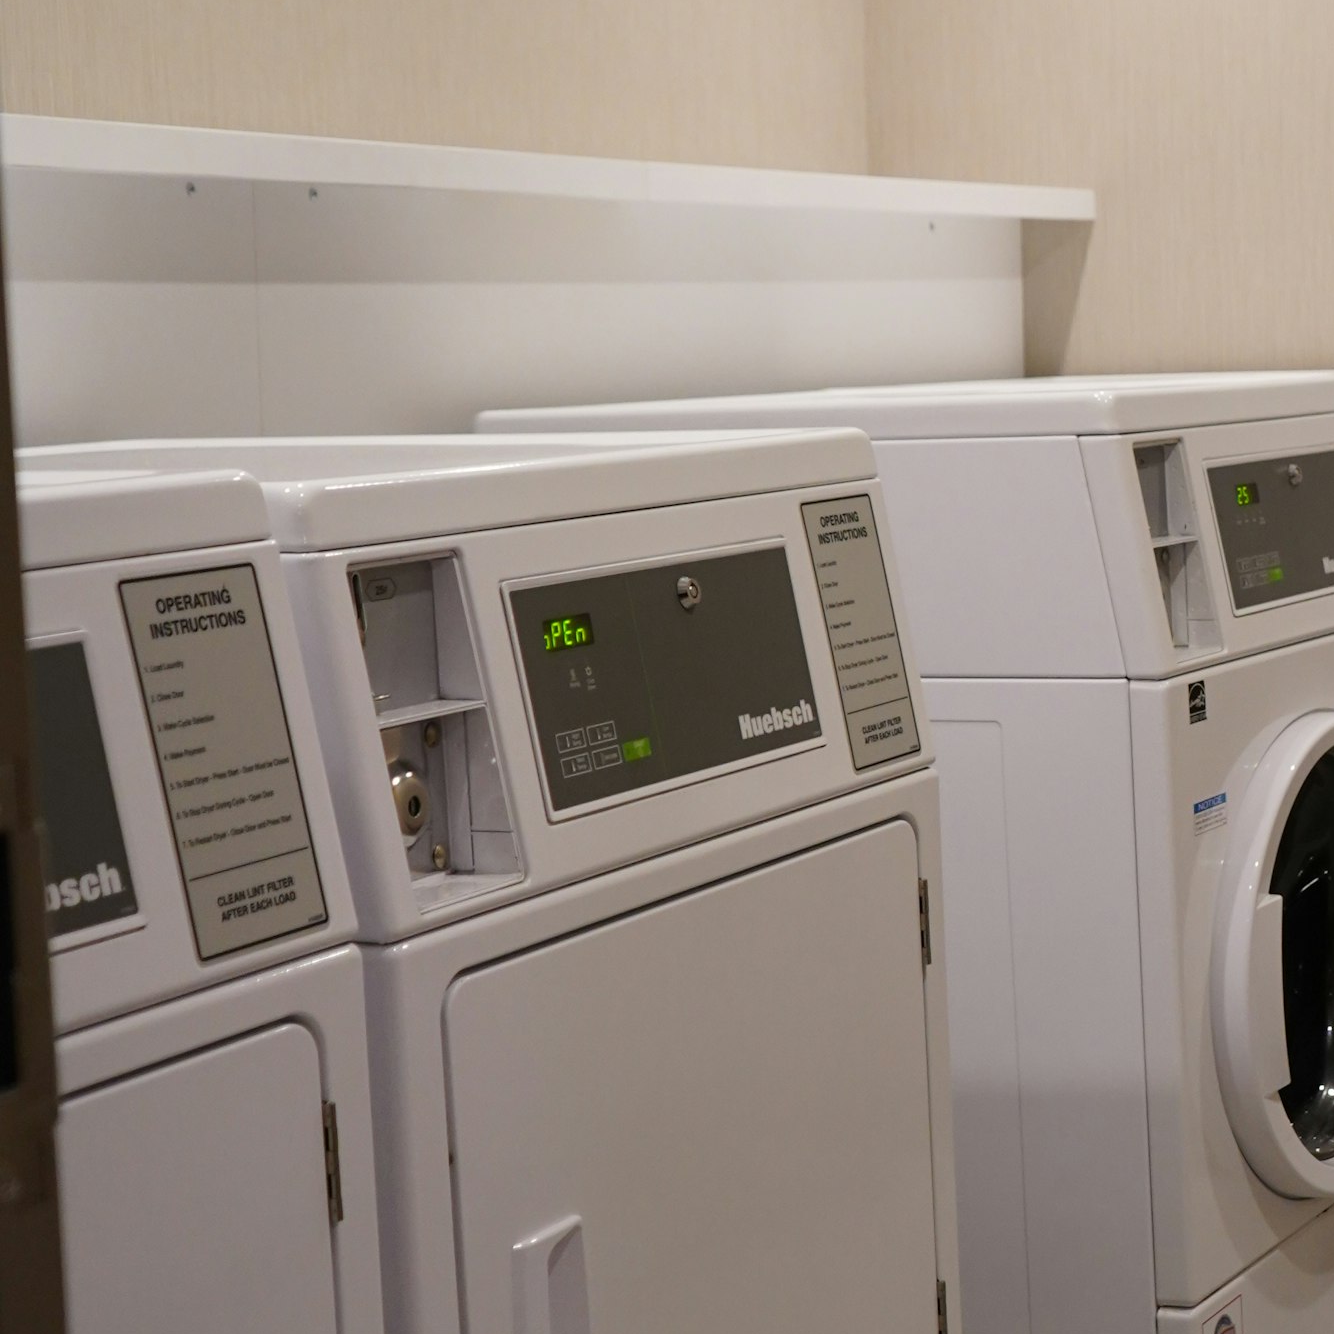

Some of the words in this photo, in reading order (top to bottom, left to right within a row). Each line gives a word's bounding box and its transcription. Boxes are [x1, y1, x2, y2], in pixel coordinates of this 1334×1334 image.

[820, 511, 859, 528] OPERATING
[818, 527, 868, 544] INSTRUCTIONS
[155, 588, 231, 614] OPERATING
[149, 609, 246, 640] INSTRUCTIONS
[739, 699, 813, 739] Huebsch
[217, 890, 246, 908] CLEAN
[247, 884, 265, 899] LINT
[266, 876, 294, 893] FILTER
[221, 905, 248, 922] AFTER
[250, 898, 273, 913] EACH
[273, 891, 296, 907] LOAD
